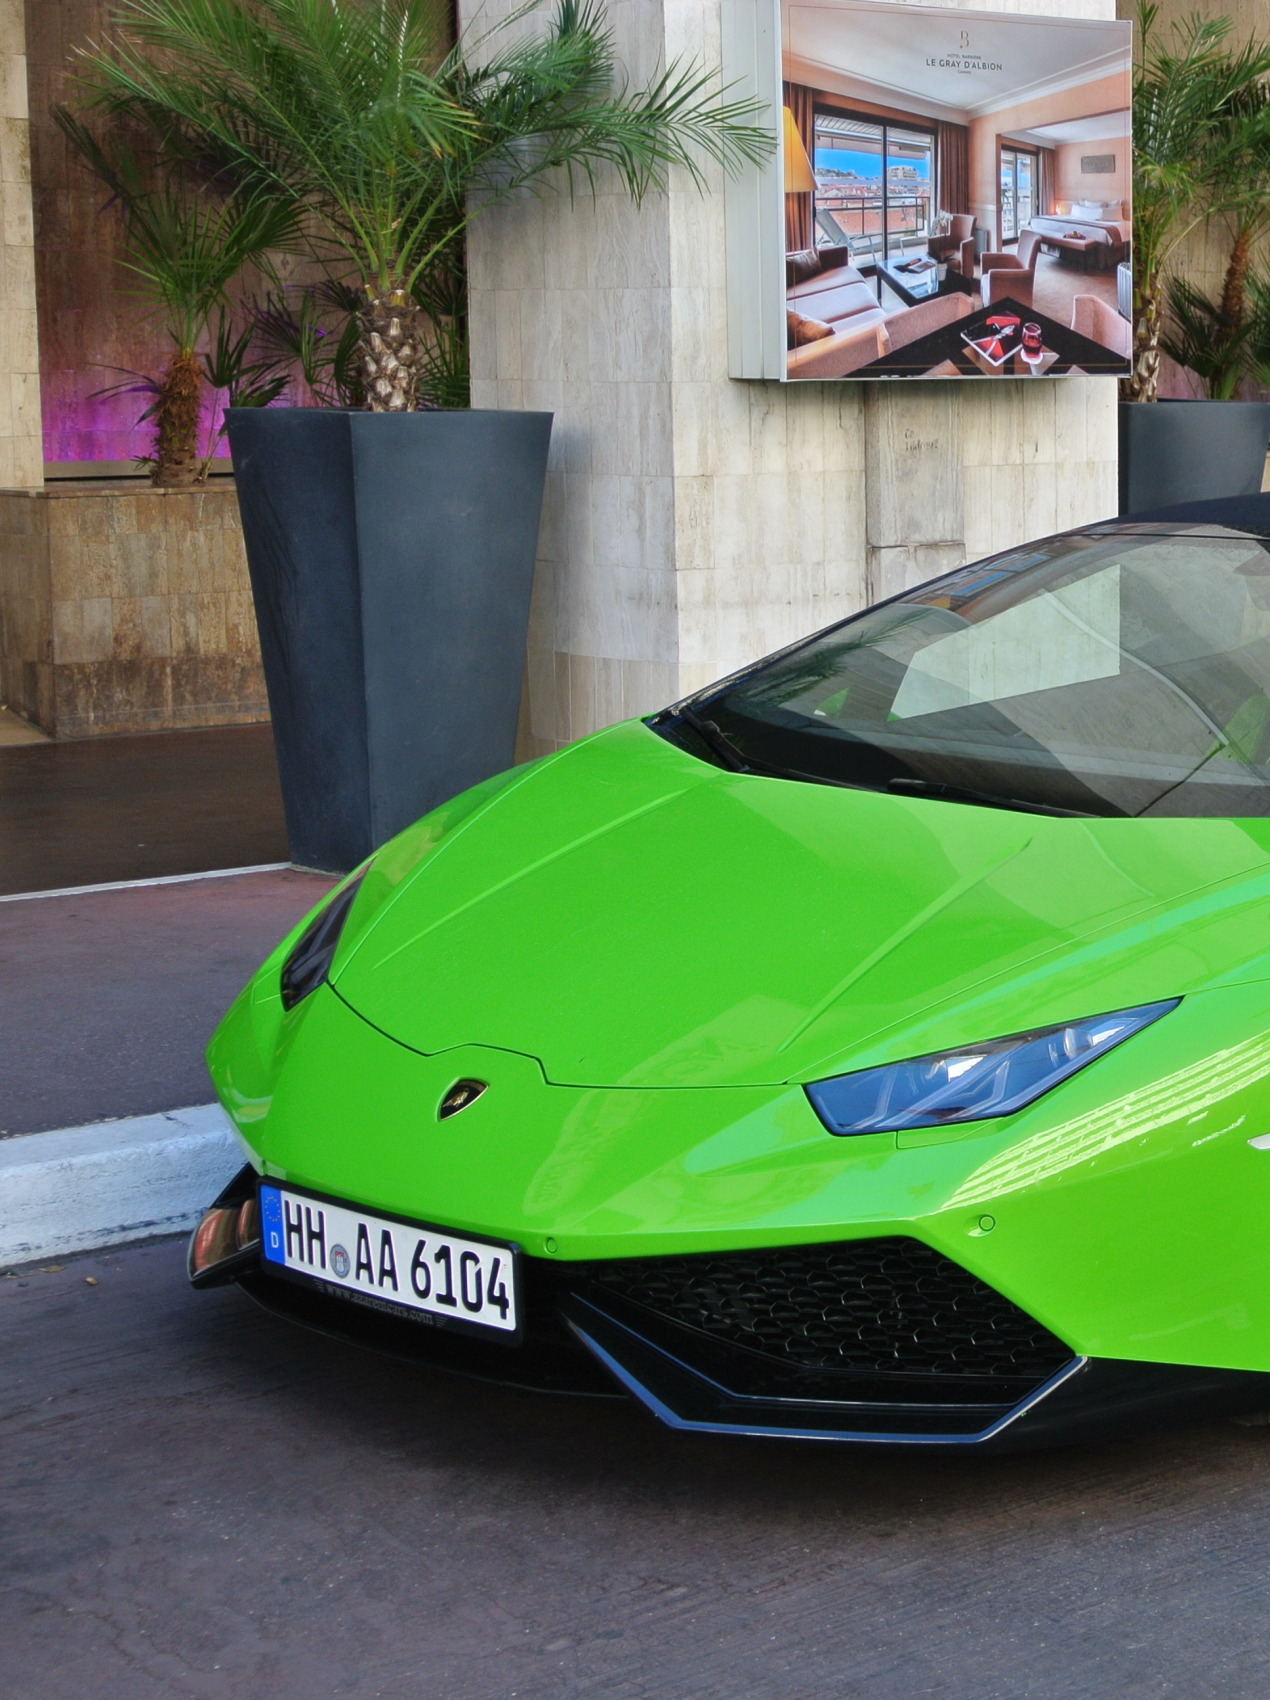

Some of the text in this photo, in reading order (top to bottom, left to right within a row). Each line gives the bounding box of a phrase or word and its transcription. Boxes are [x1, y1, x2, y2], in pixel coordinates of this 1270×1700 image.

[926, 58, 1003, 71] LE GRAY D'ALBION
[270, 1231, 279, 1249] D
[284, 1199, 510, 1320] HH AA 6104
